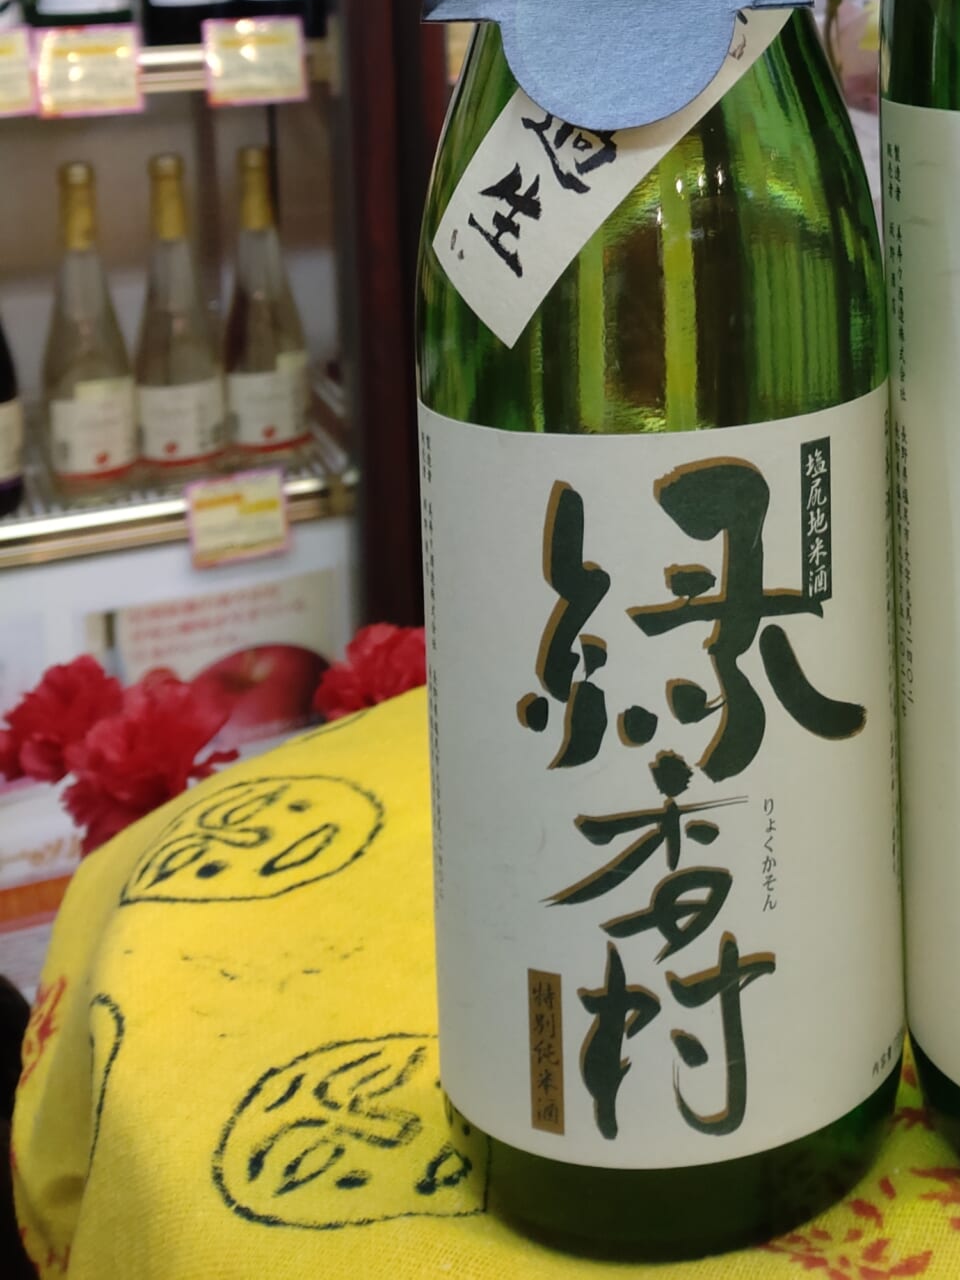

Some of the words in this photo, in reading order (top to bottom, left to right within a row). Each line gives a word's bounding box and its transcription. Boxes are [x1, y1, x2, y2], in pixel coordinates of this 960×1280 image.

[804, 448, 828, 598] 塩尻地米酒
[762, 797, 777, 912] りょくかそん
